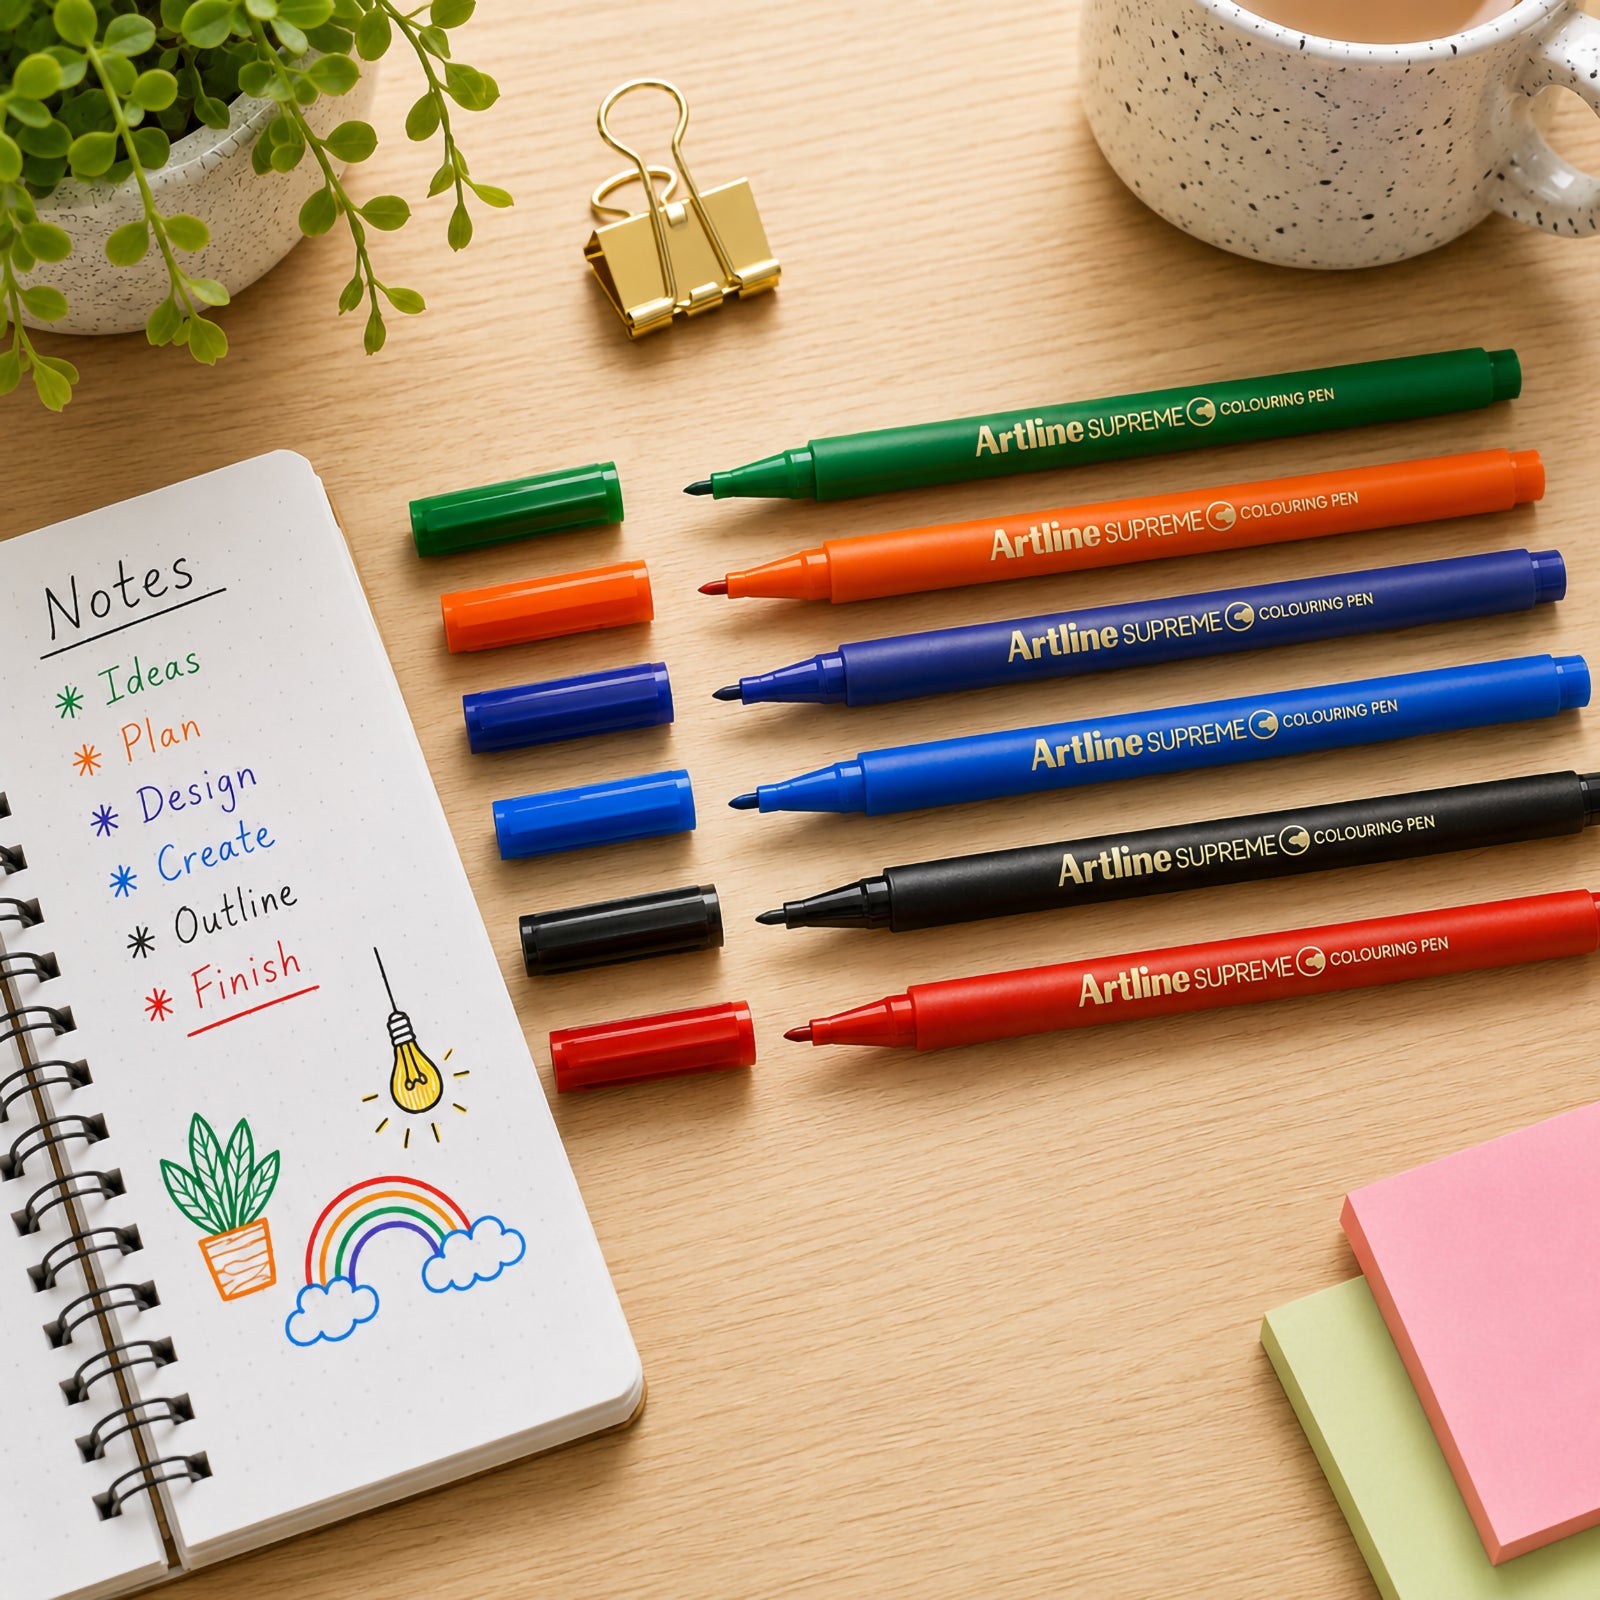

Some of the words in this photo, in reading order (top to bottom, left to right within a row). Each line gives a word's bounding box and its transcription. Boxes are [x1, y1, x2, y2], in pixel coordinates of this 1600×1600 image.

[975, 418, 1084, 457] Artline
[1088, 406, 1185, 439] SUPREME
[1220, 391, 1305, 416] COLOURING
[1308, 388, 1335, 402] PEN
[990, 521, 1101, 561] Artline
[1105, 510, 1205, 544] SUPREME
[1240, 494, 1328, 519] COLOURING
[1331, 491, 1359, 505] PEN
[45, 557, 194, 640] Notes
[1008, 622, 1118, 663] Artline
[1122, 610, 1223, 644] SUPREME
[1259, 596, 1344, 620] COLOURING
[1346, 592, 1374, 606] PEN
[98, 652, 201, 706] Ideas
[121, 717, 200, 762] Plan
[1031, 731, 1143, 771] Artline
[1147, 718, 1247, 753] SUPREME
[1282, 704, 1368, 728] COLOURING
[1370, 699, 1398, 714] PEN
[136, 766, 257, 823] Design
[157, 820, 276, 882] Create
[1058, 845, 1172, 887] Artline
[1175, 834, 1277, 868] SUPREME
[1314, 820, 1403, 845] COLOURING
[1406, 815, 1435, 831] PEN
[175, 883, 298, 944] Outline
[192, 940, 300, 1009] Finish
[1078, 966, 1190, 1008] Artline
[1194, 956, 1294, 989] SUPREME
[1330, 941, 1418, 966] COLOURING
[1421, 936, 1449, 952] PEN
